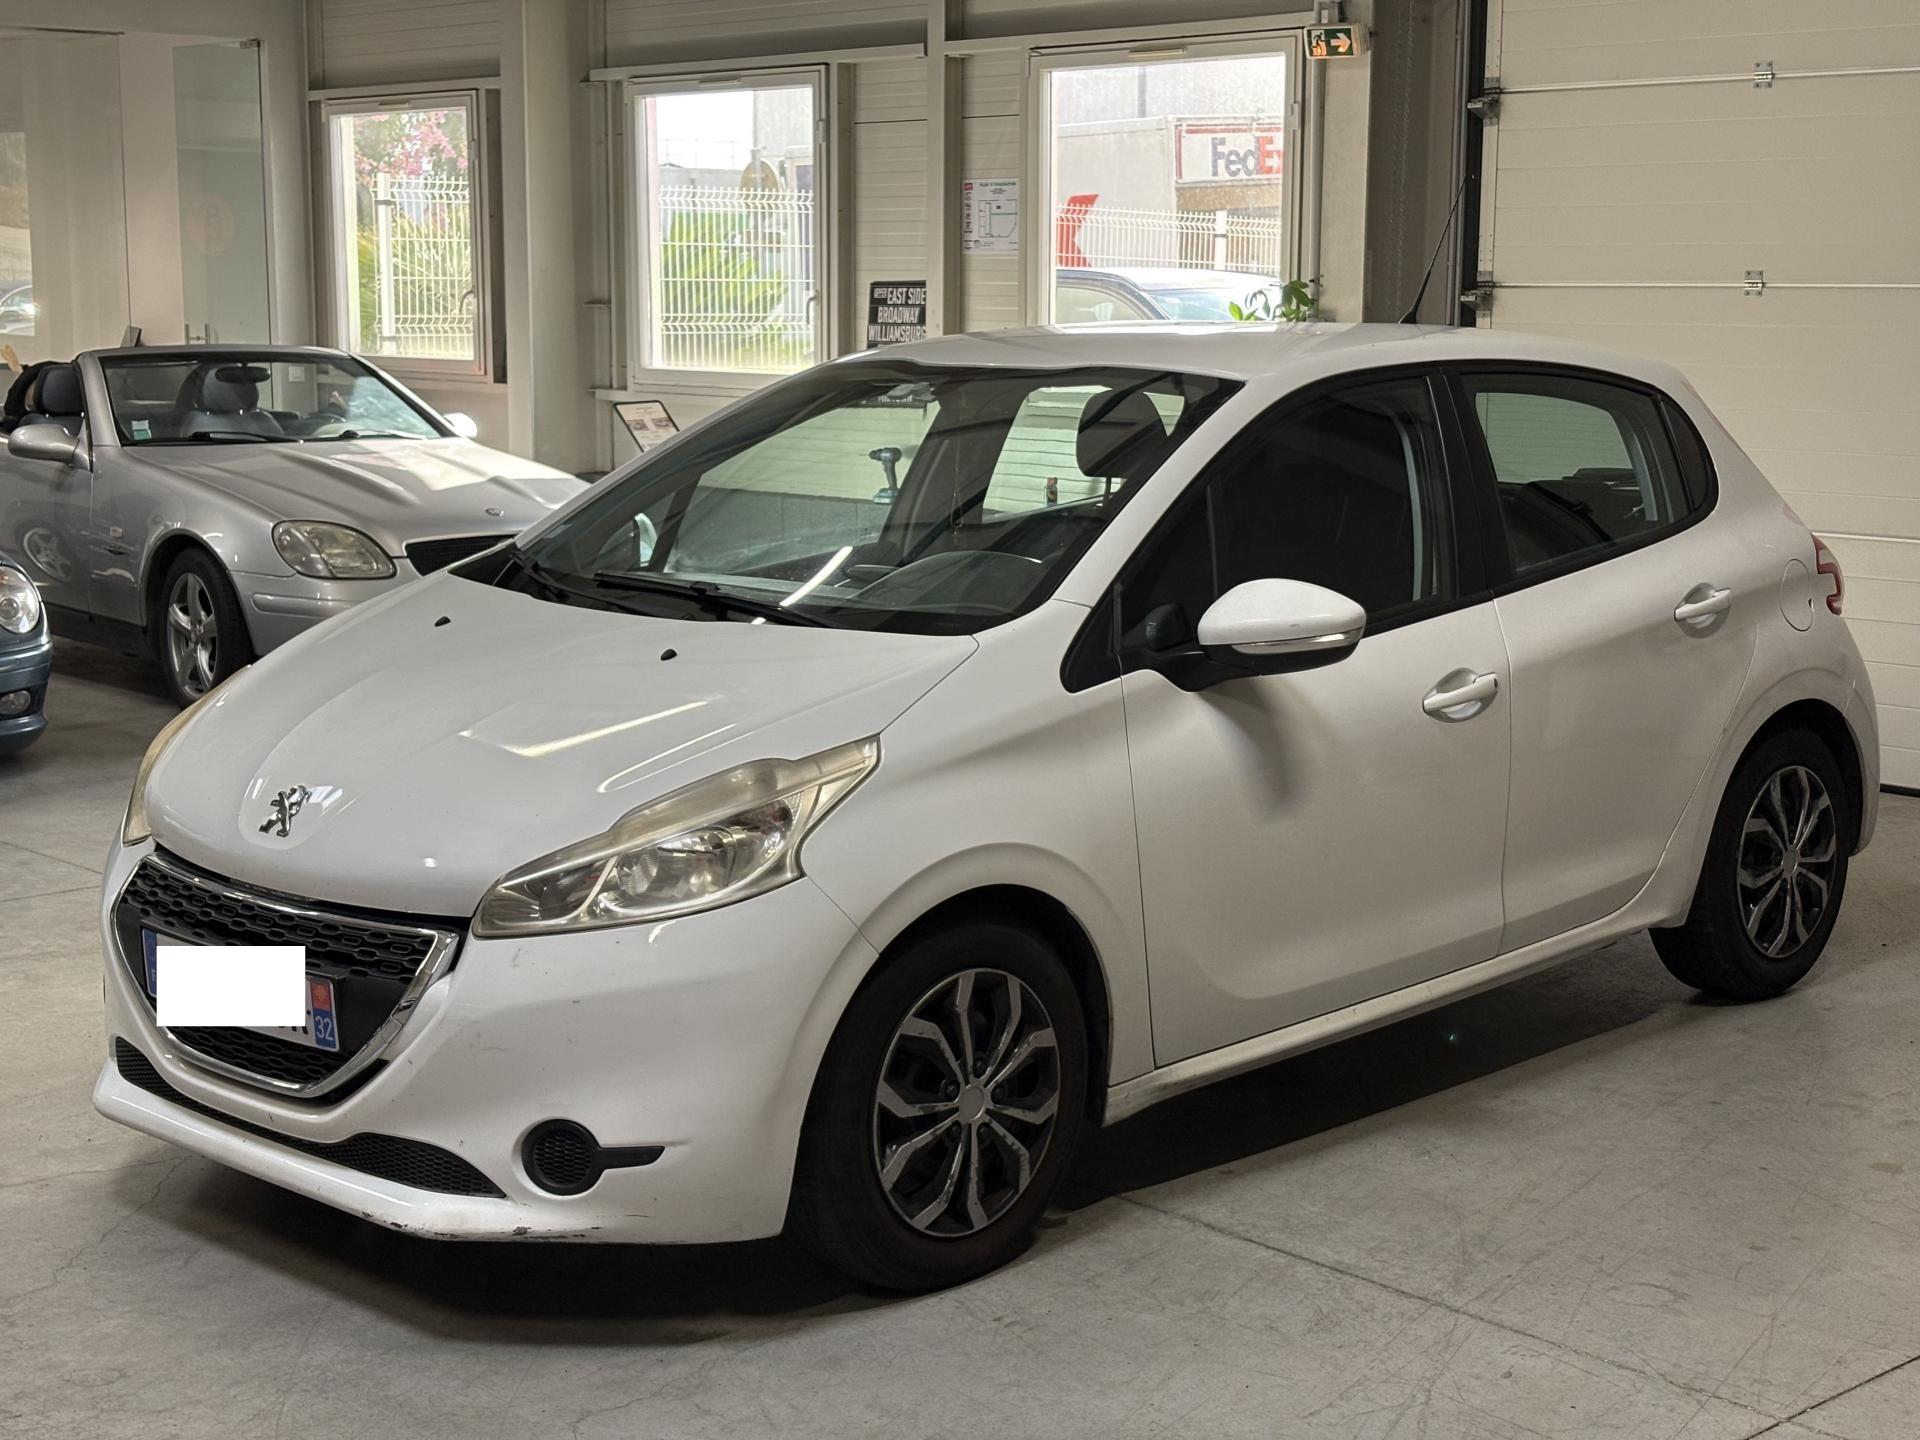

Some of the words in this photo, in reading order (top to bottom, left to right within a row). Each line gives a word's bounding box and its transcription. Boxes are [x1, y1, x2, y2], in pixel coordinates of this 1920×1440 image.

[887, 287, 907, 305] EAST
[908, 287, 926, 305] SIDE
[877, 306, 920, 324] BROADWAY
[315, 1015, 333, 1041] 32
